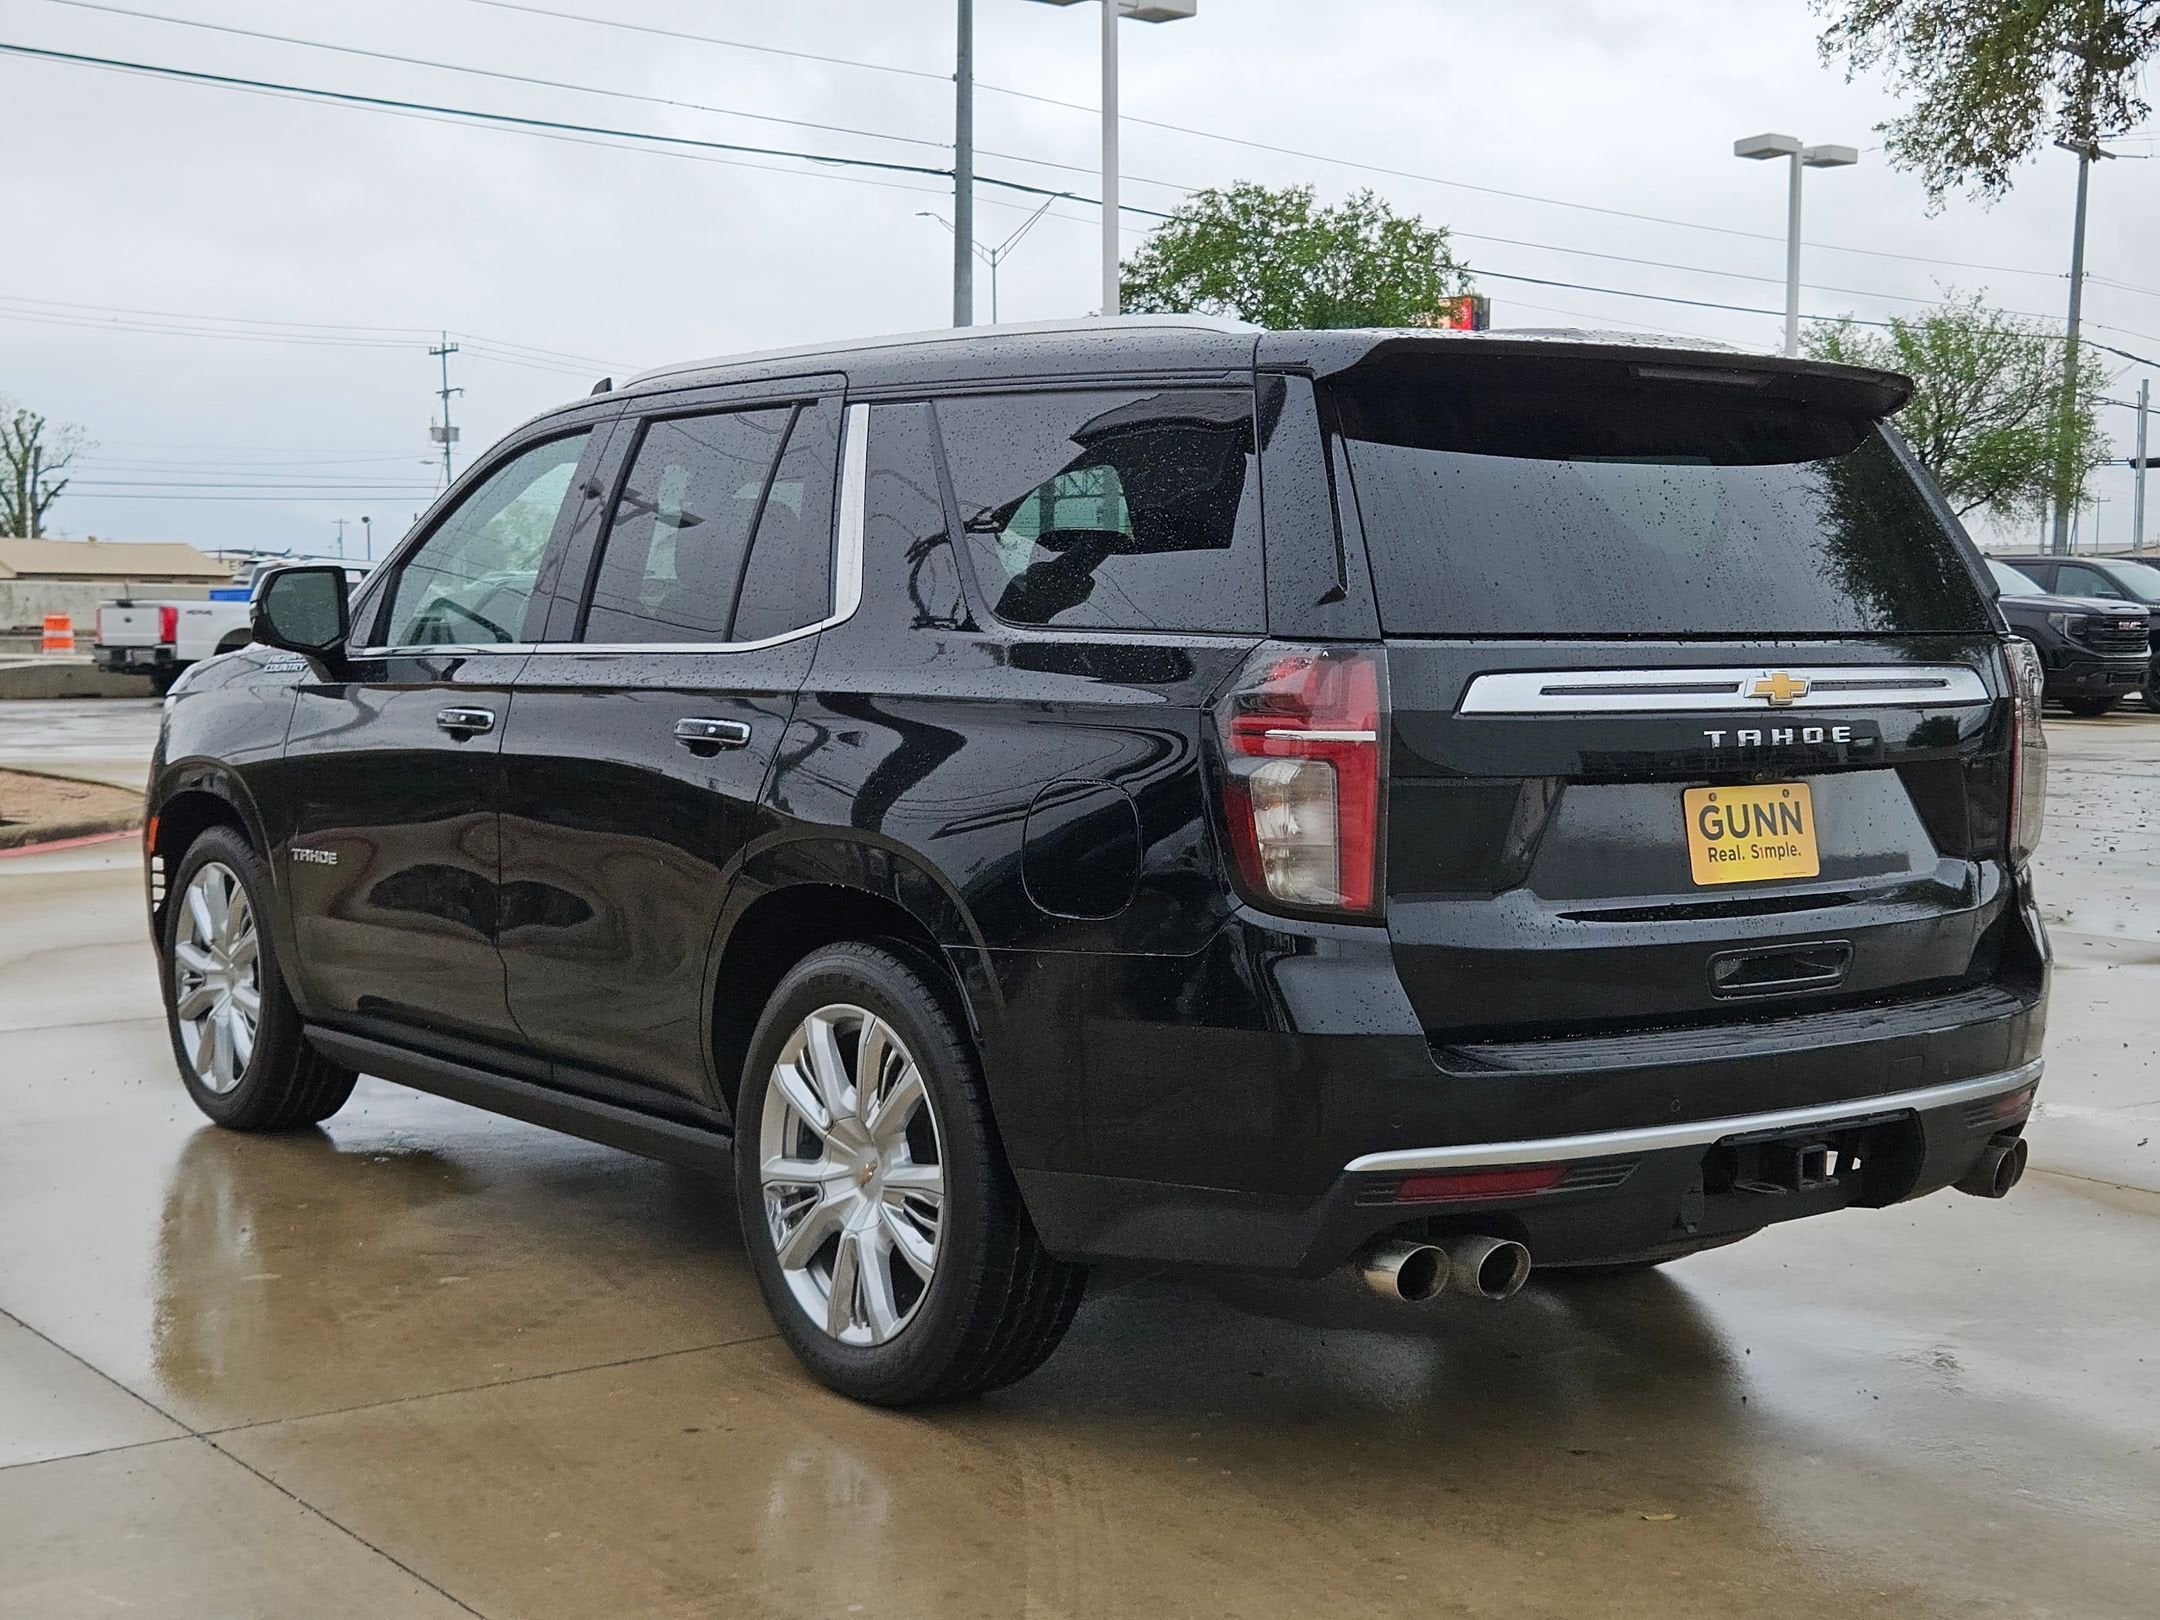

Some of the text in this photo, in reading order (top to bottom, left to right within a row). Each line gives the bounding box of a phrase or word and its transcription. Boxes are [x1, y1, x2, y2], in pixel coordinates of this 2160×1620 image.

[263, 663, 308, 672] COUNTRY
[1703, 726, 1851, 748] TAHOE
[1698, 801, 1804, 841] GUNN
[291, 848, 338, 864] TAHOE
[1708, 844, 1745, 863] Real.
